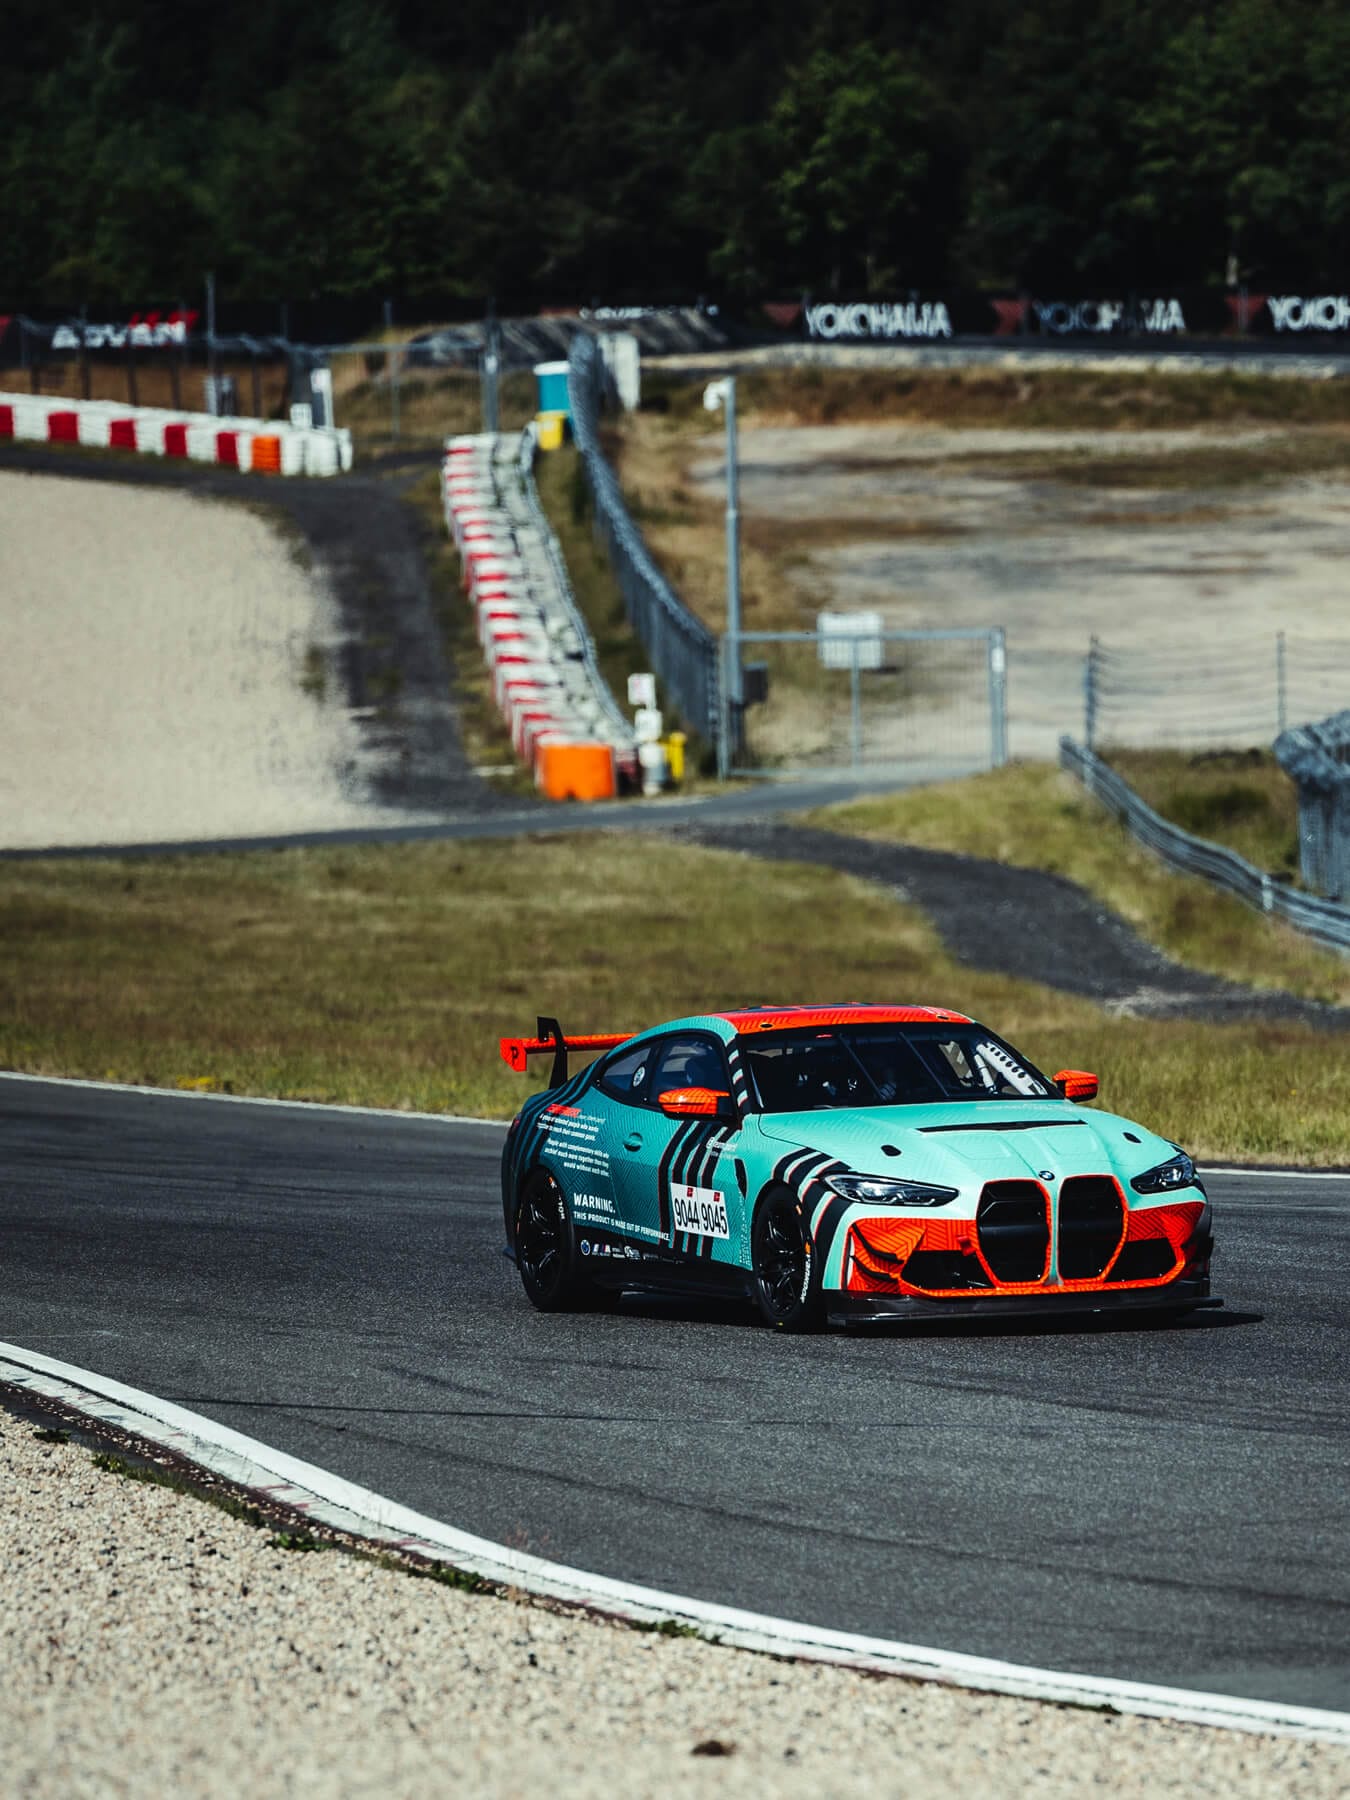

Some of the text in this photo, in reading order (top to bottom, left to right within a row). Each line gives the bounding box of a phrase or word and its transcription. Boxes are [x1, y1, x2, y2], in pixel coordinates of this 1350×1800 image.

[805, 302, 952, 338] YOKOHAMA
[52, 321, 187, 349] ADVAN
[573, 1192, 616, 1214] WARNING.
[674, 1197, 700, 1230] 9044
[701, 1202, 728, 1235] 9045
[573, 1211, 587, 1221] THIS
[587, 1213, 610, 1225] PRODUCT
